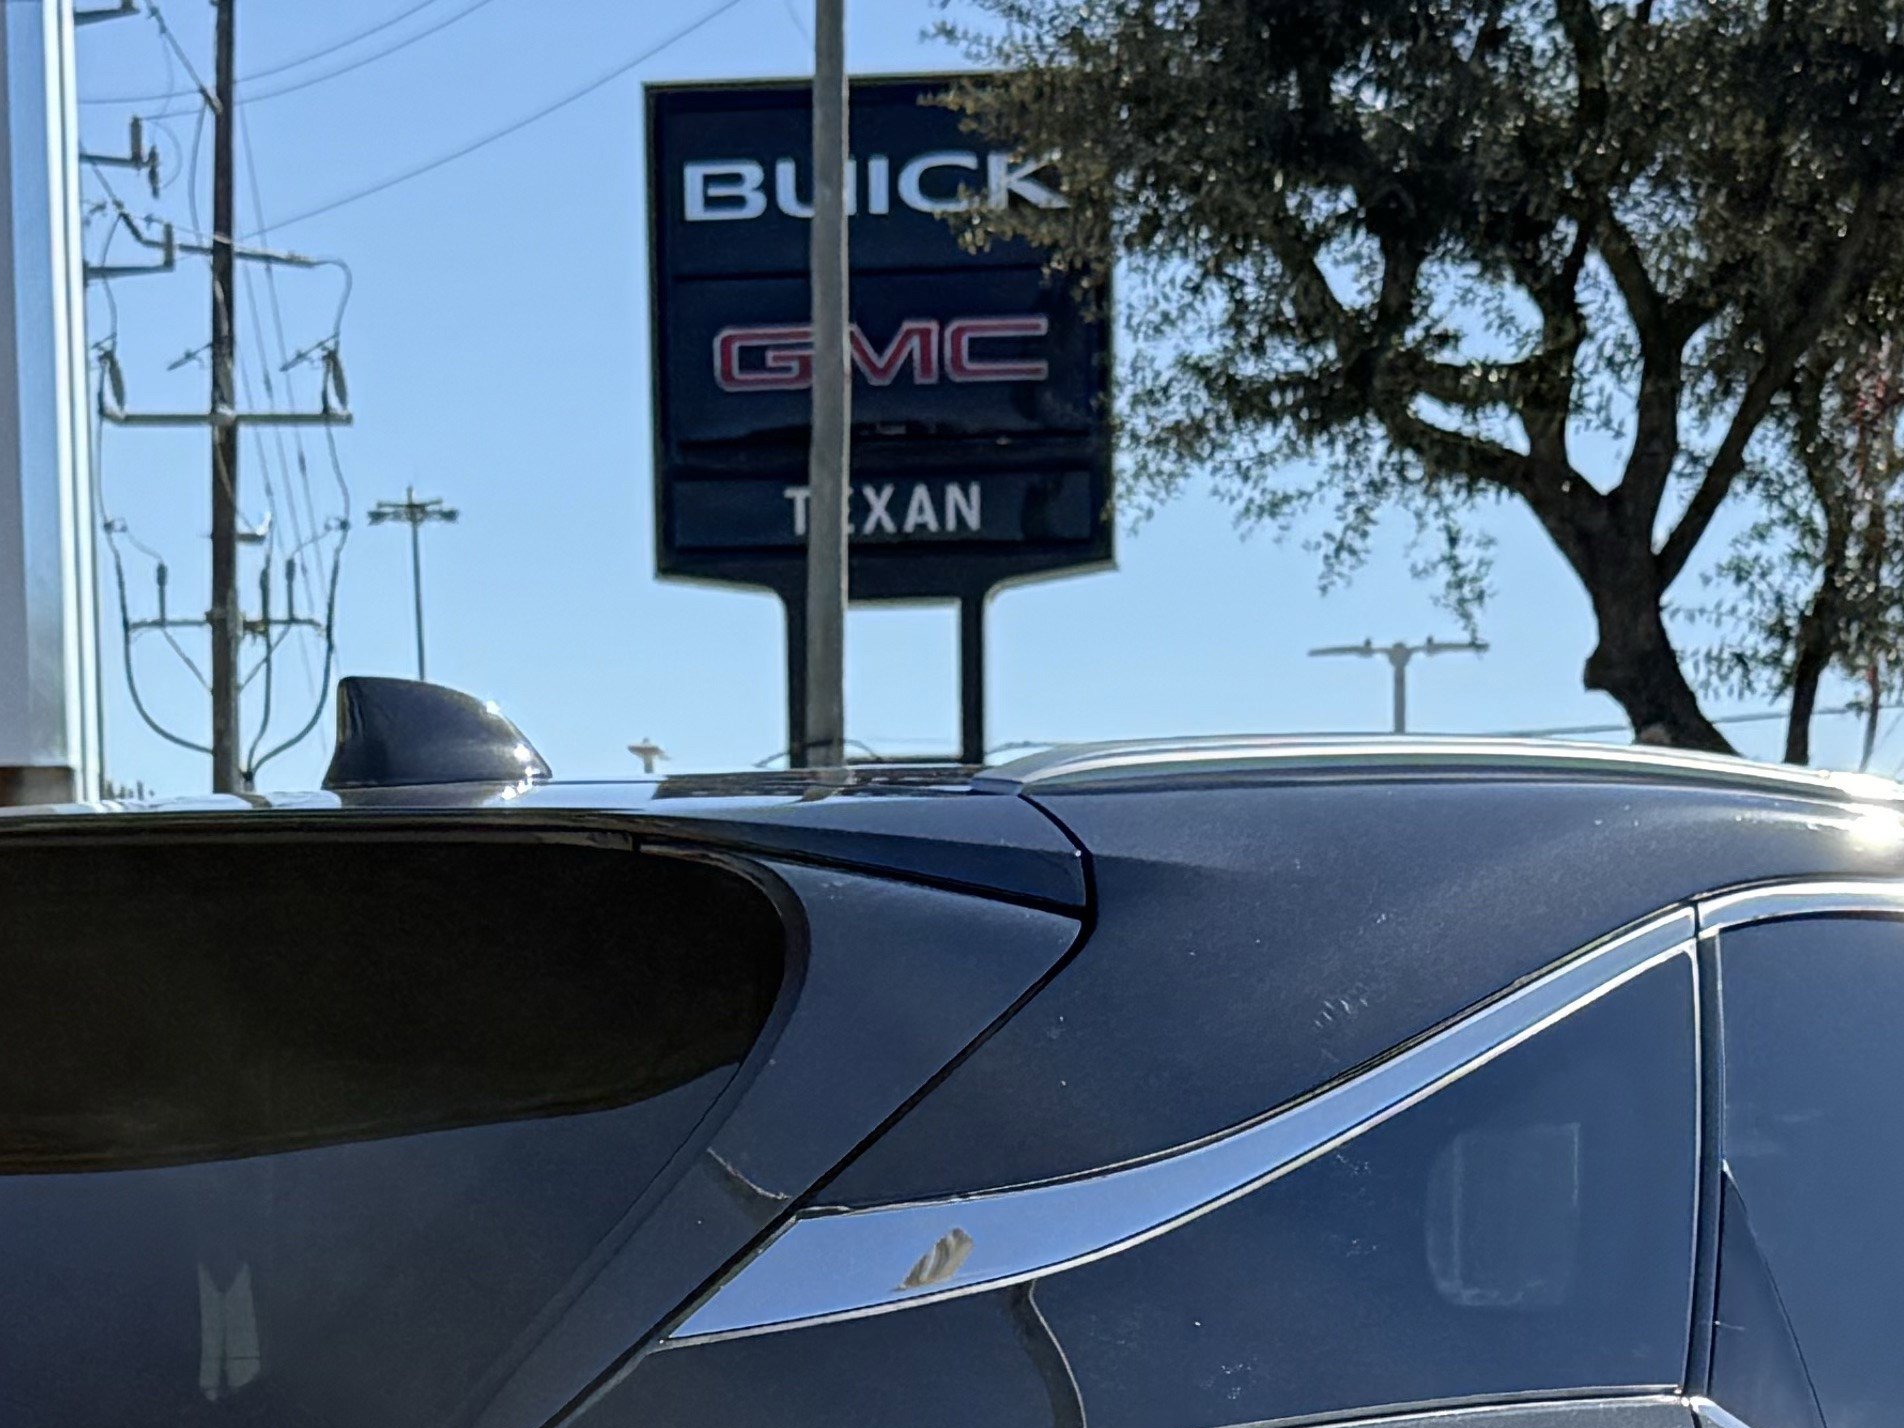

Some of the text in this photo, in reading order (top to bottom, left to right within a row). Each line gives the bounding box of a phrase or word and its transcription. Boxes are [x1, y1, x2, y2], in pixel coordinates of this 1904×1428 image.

[683, 150, 1069, 222] BUICK
[713, 314, 1049, 392] GMC
[784, 482, 982, 536] TXAN
